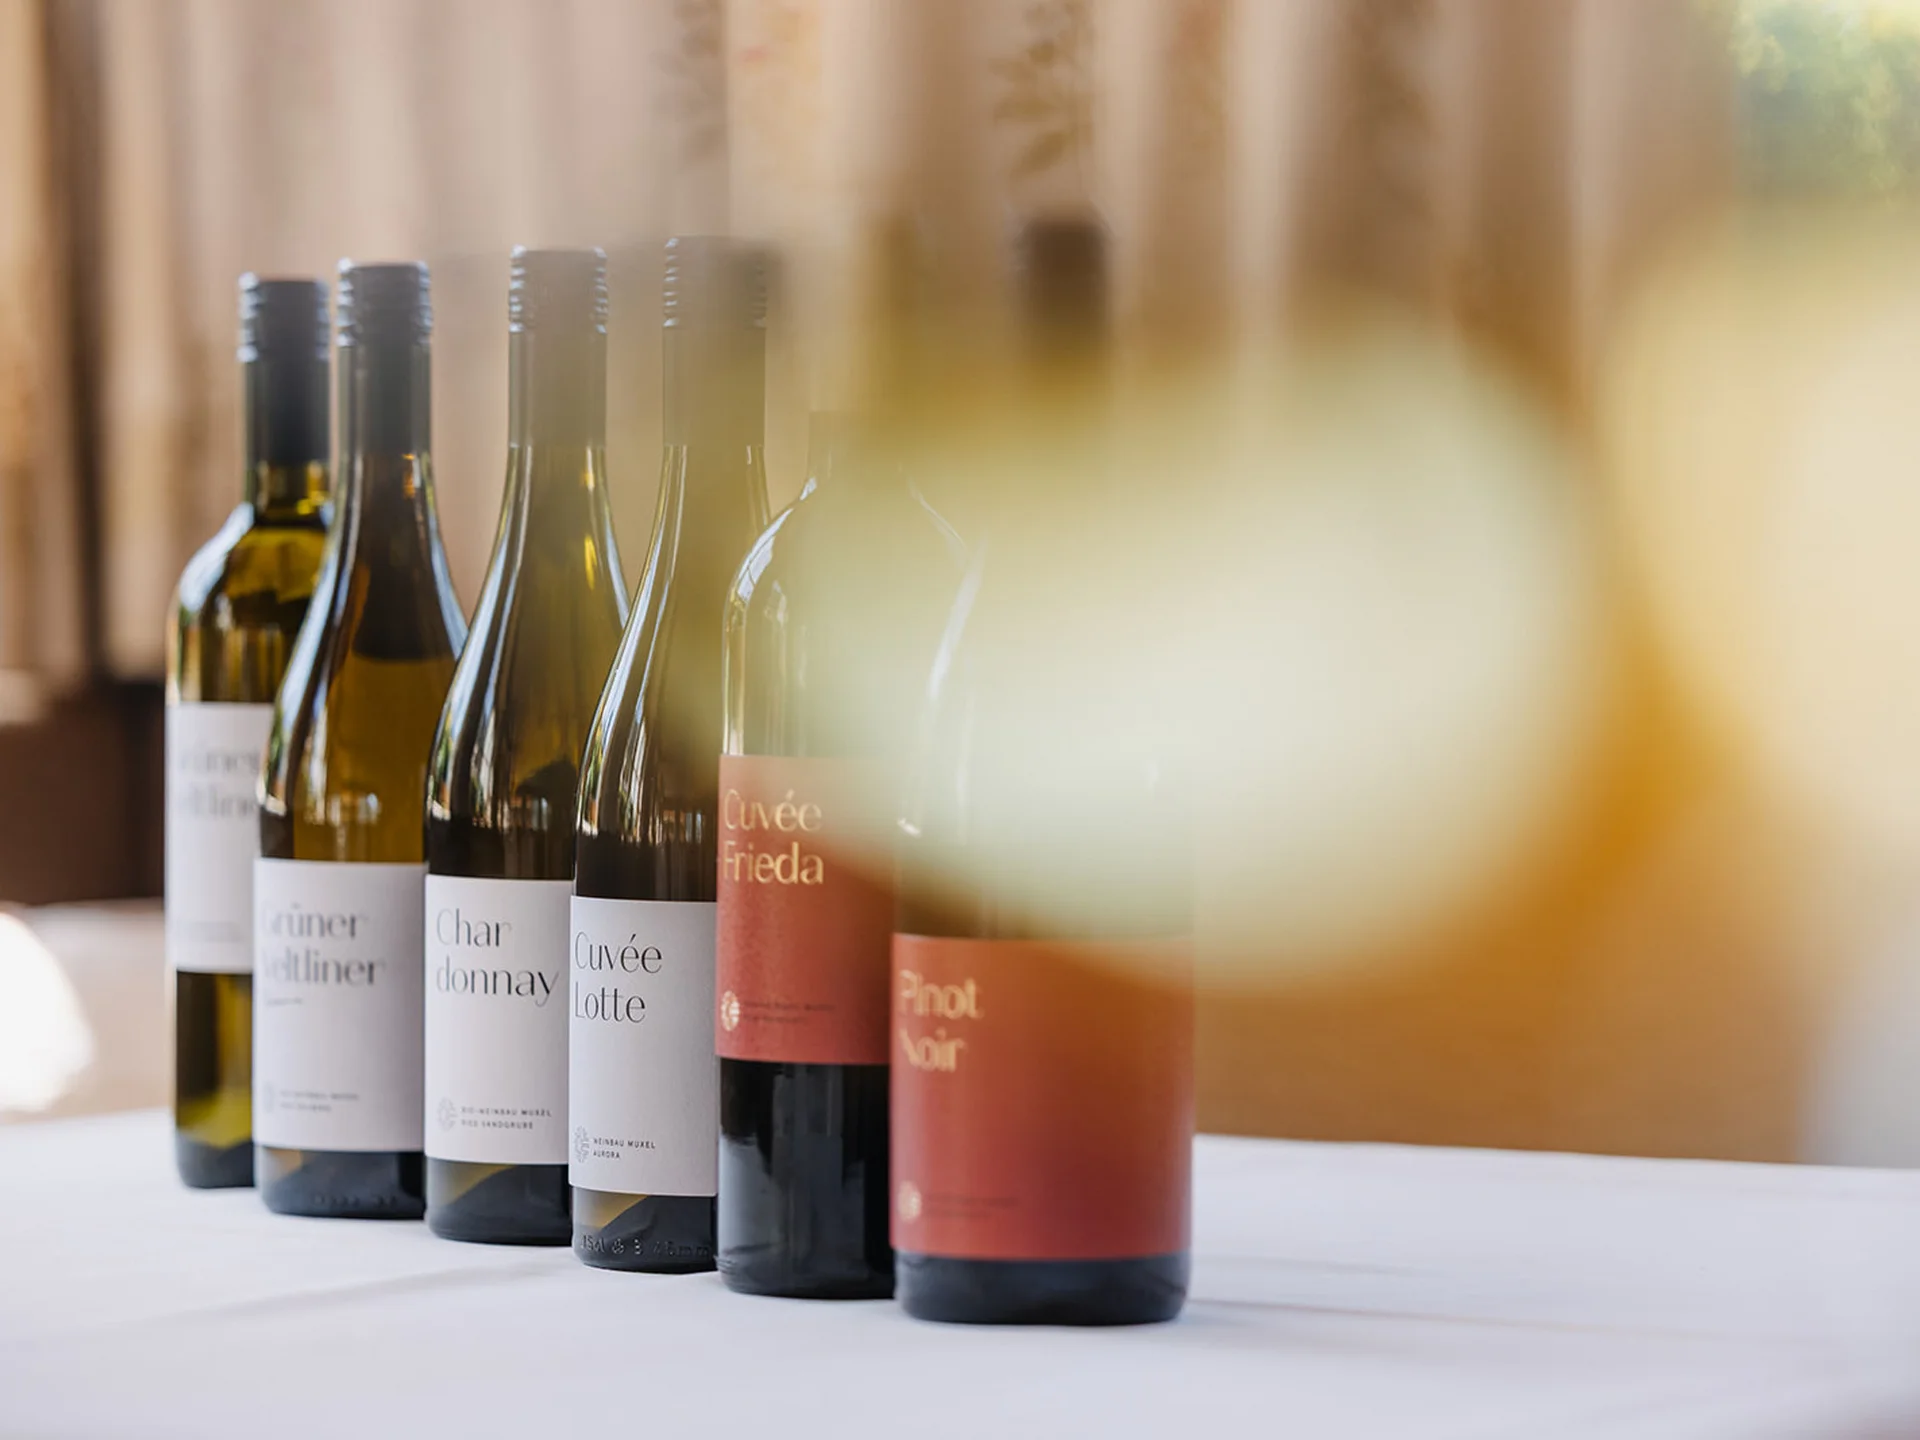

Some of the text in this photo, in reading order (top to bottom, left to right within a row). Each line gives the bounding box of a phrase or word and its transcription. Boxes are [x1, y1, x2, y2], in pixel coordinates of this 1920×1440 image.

[723, 788, 823, 832] Cuvée
[722, 840, 825, 885] Frieda
[437, 908, 512, 947] Char
[575, 931, 662, 973] Cuvée
[437, 955, 559, 1007] donnay
[575, 981, 645, 1023] Lotte
[593, 1137, 656, 1149] WEINBAU MUXEL
[593, 1150, 620, 1159] AURORA
